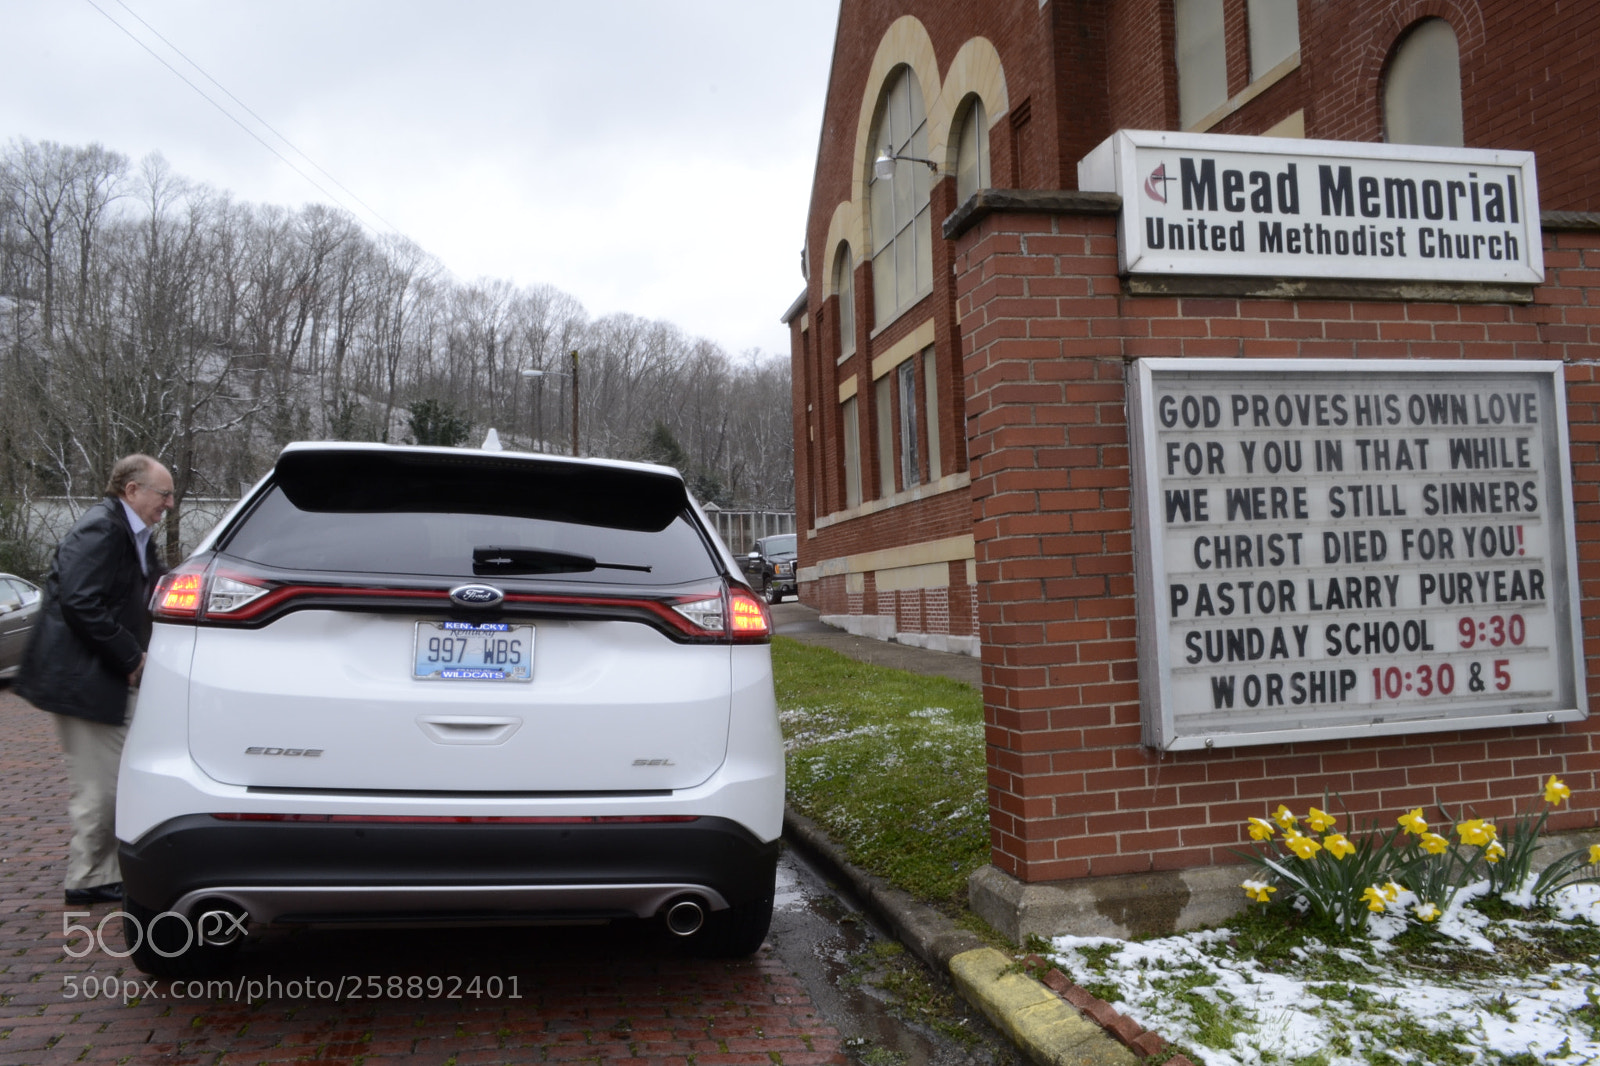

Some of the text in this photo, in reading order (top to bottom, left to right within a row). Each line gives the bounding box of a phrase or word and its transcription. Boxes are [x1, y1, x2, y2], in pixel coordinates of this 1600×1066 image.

[1179, 157, 1520, 224] Mead Memorial
[1145, 216, 1520, 261] United Methodist Church
[1159, 393, 1538, 428] GOD PROVES HIS OWN LOVE
[1166, 437, 1530, 475] FOR YOU IN THAT WHILE
[1165, 481, 1538, 523] WE WERE STILL SINNERS
[1194, 524, 1526, 569] CHRIST DIED FOR YOU!
[462, 589, 491, 601] Ford
[1170, 569, 1545, 617] PASTOR LARRY PURYEAR
[428, 637, 522, 665] 997 WBS
[1185, 614, 1526, 664] SUNDAY SCHOOL 9:30
[443, 671, 503, 679] WILDCATS
[1211, 660, 1511, 709] WORSHIP 10:30 & 5
[244, 746, 325, 757] EDGE
[632, 757, 676, 767] SEL
